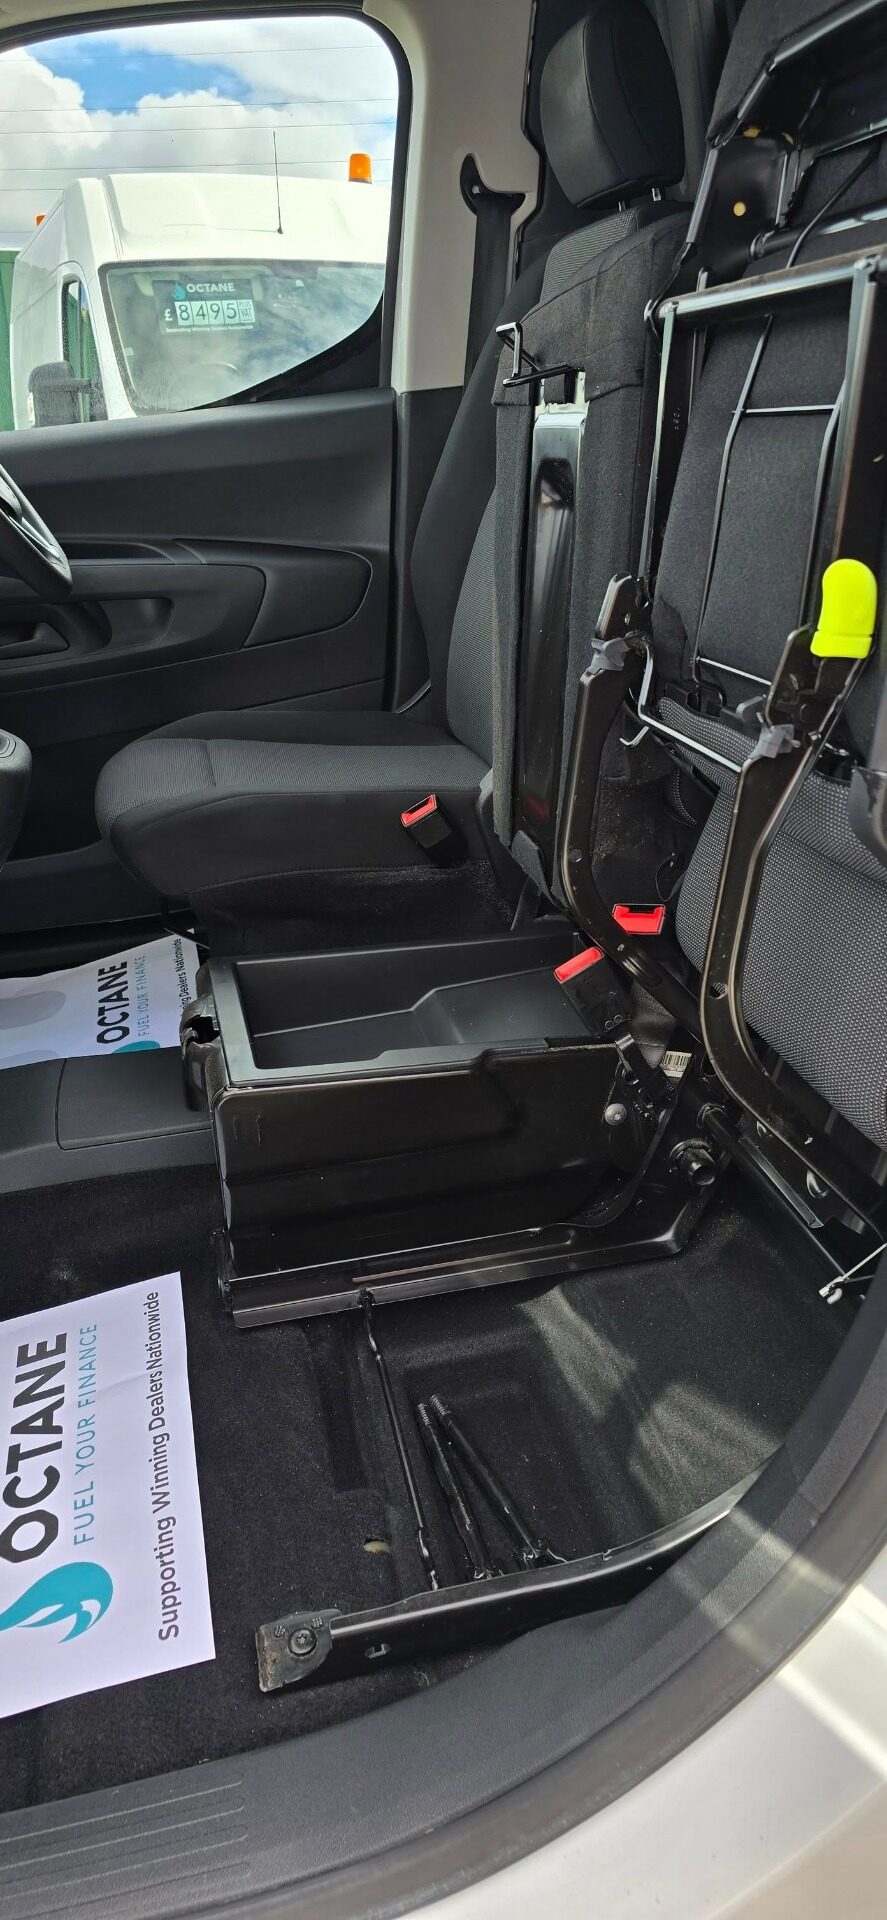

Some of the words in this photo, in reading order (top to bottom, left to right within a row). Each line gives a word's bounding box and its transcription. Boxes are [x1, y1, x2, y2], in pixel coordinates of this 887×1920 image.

[164, 309, 173, 320] £
[178, 303, 237, 321] 8495
[186, 282, 235, 293] OCTANE
[240, 307, 252, 318] VAT
[134, 955, 148, 990] FINANCE
[171, 938, 186, 972] Nationwide
[177, 972, 190, 997] Dealers
[96, 961, 130, 1044] OCTANE
[137, 992, 149, 1014] YOUR
[138, 1015, 150, 1036] FUEL
[143, 1291, 163, 1370] Nationwide
[74, 1323, 98, 1409] FINANCE
[146, 1370, 166, 1432] Dealers
[0, 1332, 68, 1564] OCTANE
[75, 1414, 96, 1478] YOUR
[148, 1432, 172, 1514] Winning
[74, 1480, 95, 1546] FUEL
[154, 1515, 181, 1641] Supporting
